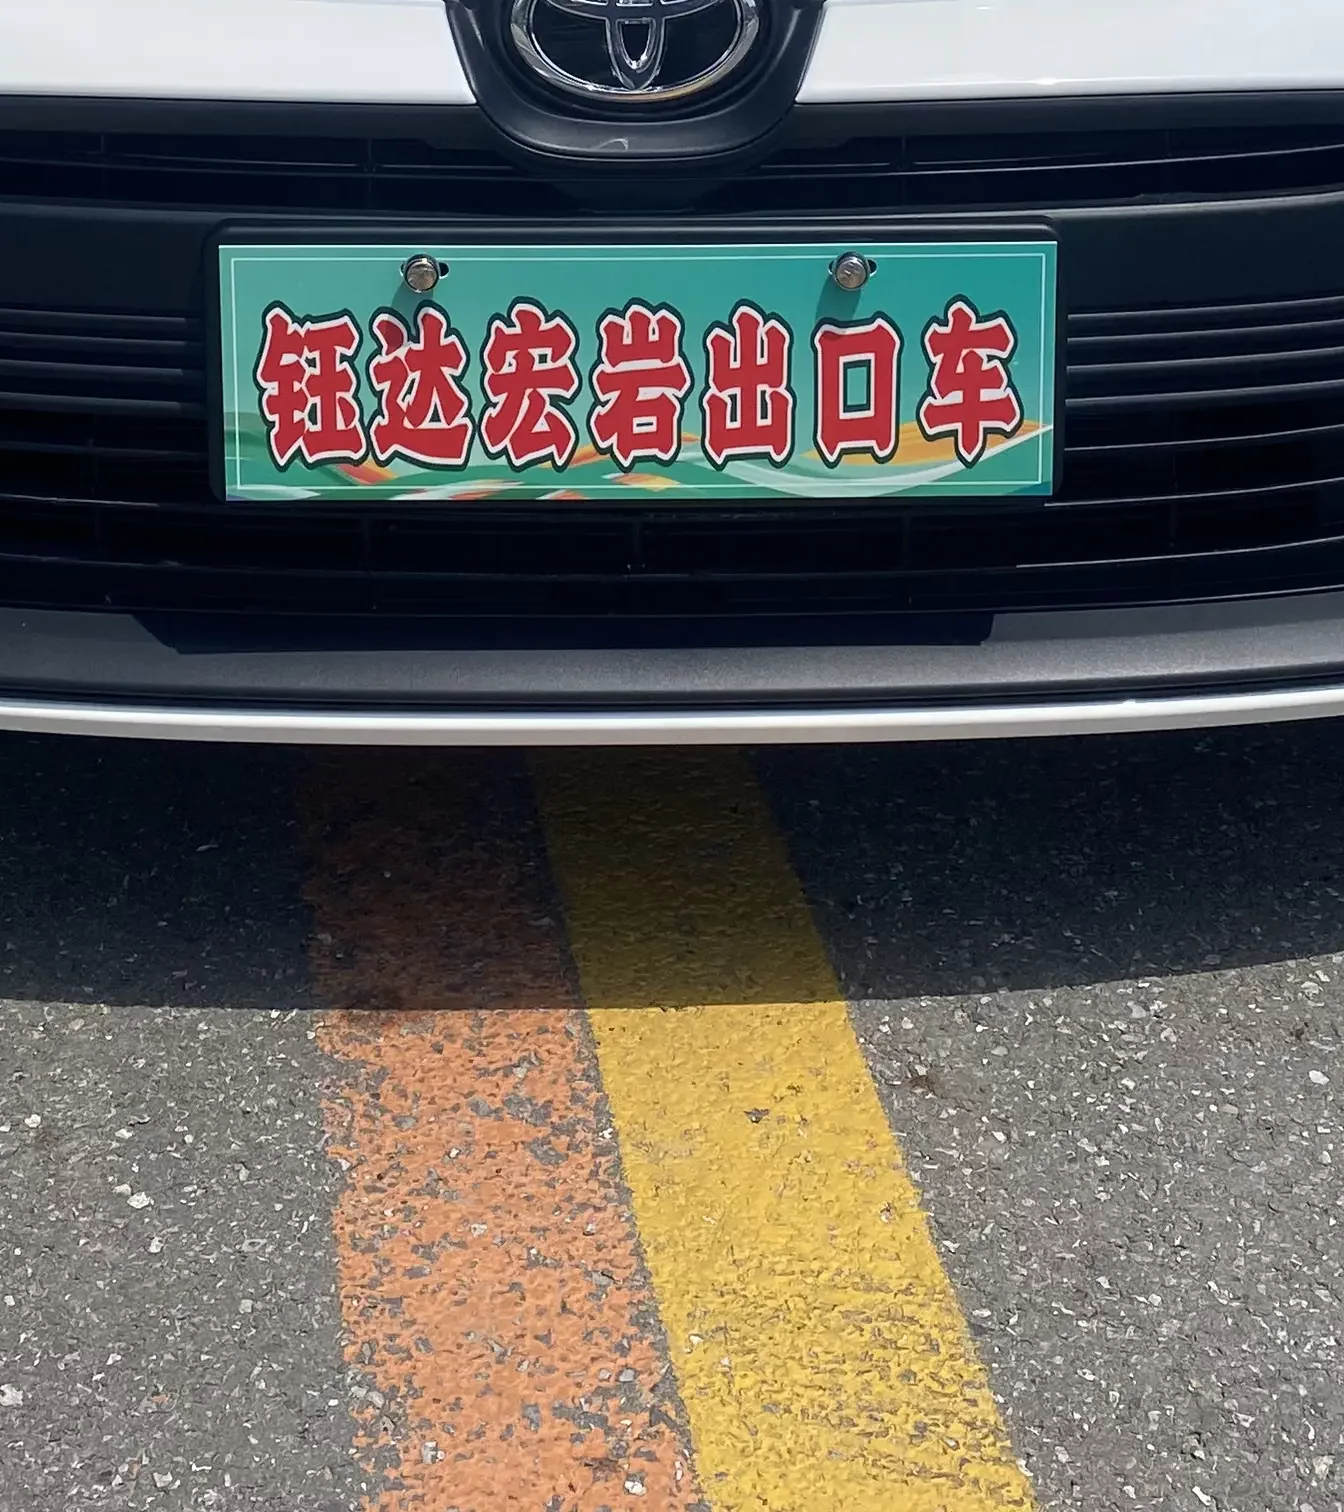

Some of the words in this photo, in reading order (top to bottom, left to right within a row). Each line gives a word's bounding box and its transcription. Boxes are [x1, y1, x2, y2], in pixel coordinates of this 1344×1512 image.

[255, 296, 1024, 472] 钰达宏岩出口车
